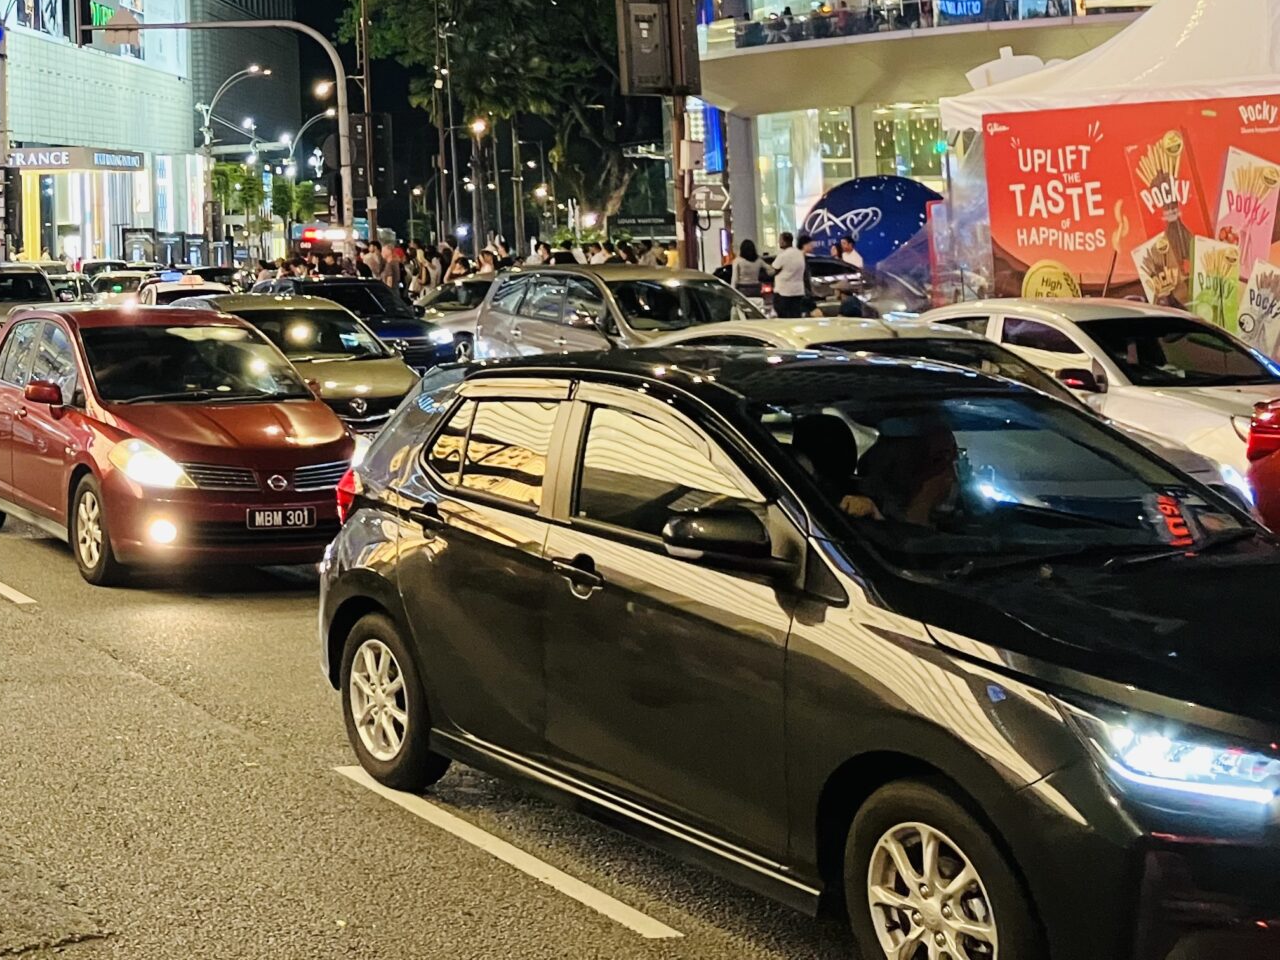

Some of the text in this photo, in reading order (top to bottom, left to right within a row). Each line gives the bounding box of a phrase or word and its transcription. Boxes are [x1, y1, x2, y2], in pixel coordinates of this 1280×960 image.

[8, 151, 69, 167] TRANCE
[1018, 145, 1091, 174] UPLIFT
[1062, 172, 1081, 184] THE
[1009, 179, 1105, 222] TASTE
[1017, 227, 1106, 252] HAPPINESS
[1041, 276, 1063, 291] High
[255, 509, 309, 526] MBM 301
